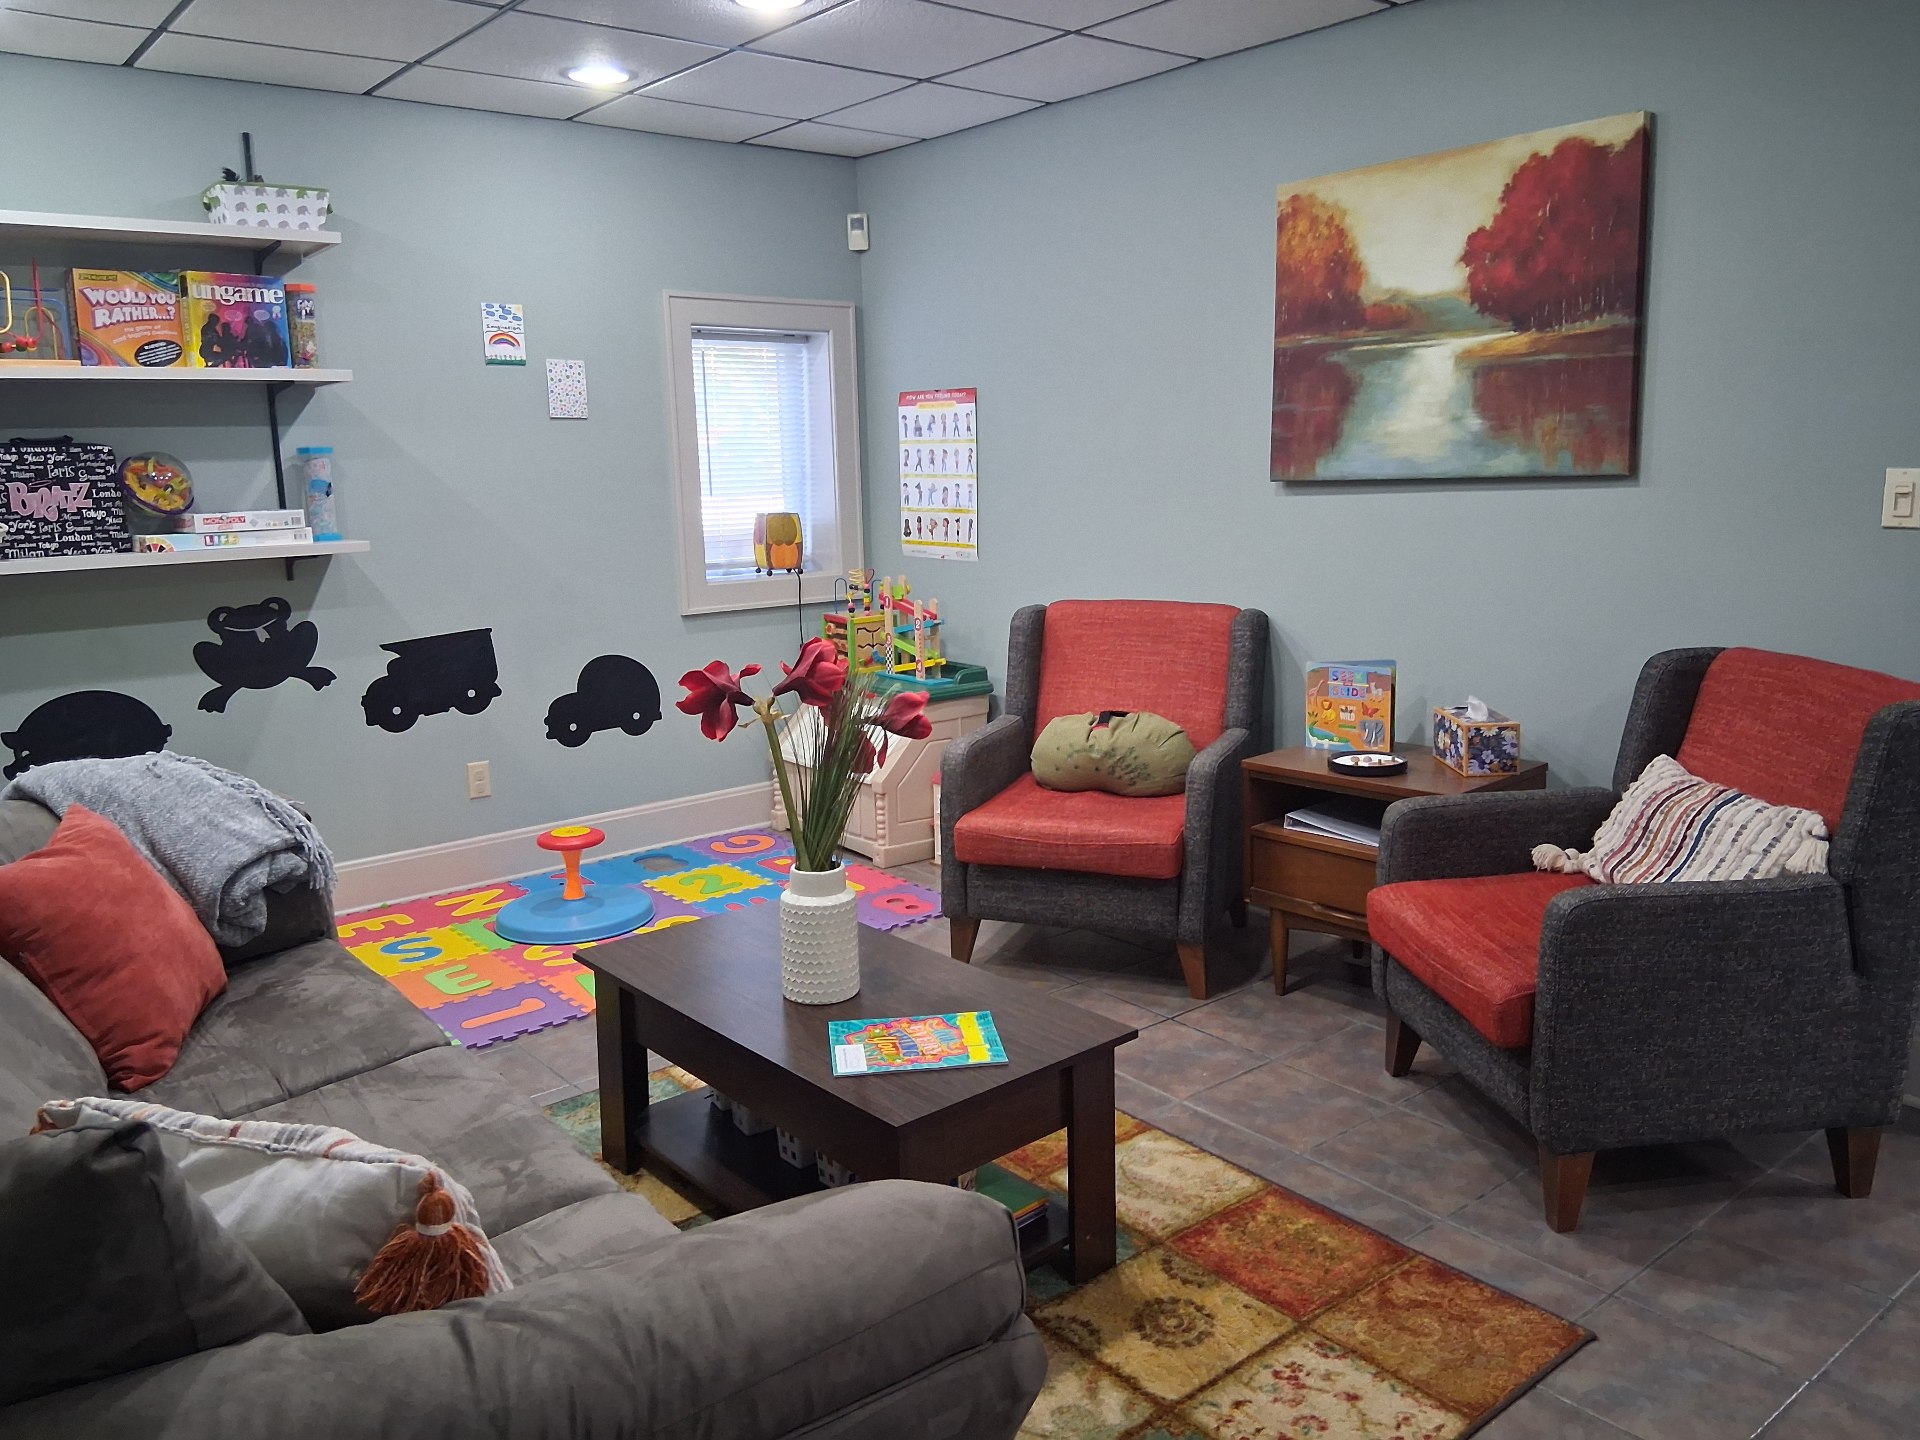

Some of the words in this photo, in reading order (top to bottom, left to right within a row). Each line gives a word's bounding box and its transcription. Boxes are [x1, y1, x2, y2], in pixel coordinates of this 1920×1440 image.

[83, 287, 147, 305] WOULD
[149, 292, 176, 305] YOU
[192, 284, 284, 306] ungame
[47, 464, 76, 479] Paris
[81, 509, 107, 521] Tokyo
[203, 517, 245, 525] MONPOLY
[9, 520, 36, 532] York
[38, 521, 63, 534] Paris
[55, 533, 93, 542] London
[205, 535, 239, 546] LIFE
[5, 548, 44, 558] Milan
[1332, 670, 1365, 683] SEEK
[1333, 686, 1366, 698] SLIDE
[679, 874, 743, 895] 2
[871, 893, 936, 915] 8
[424, 964, 494, 995] E
[865, 1036, 900, 1056] You
[887, 1029, 920, 1057] THING
[908, 1024, 943, 1056] EVERY
